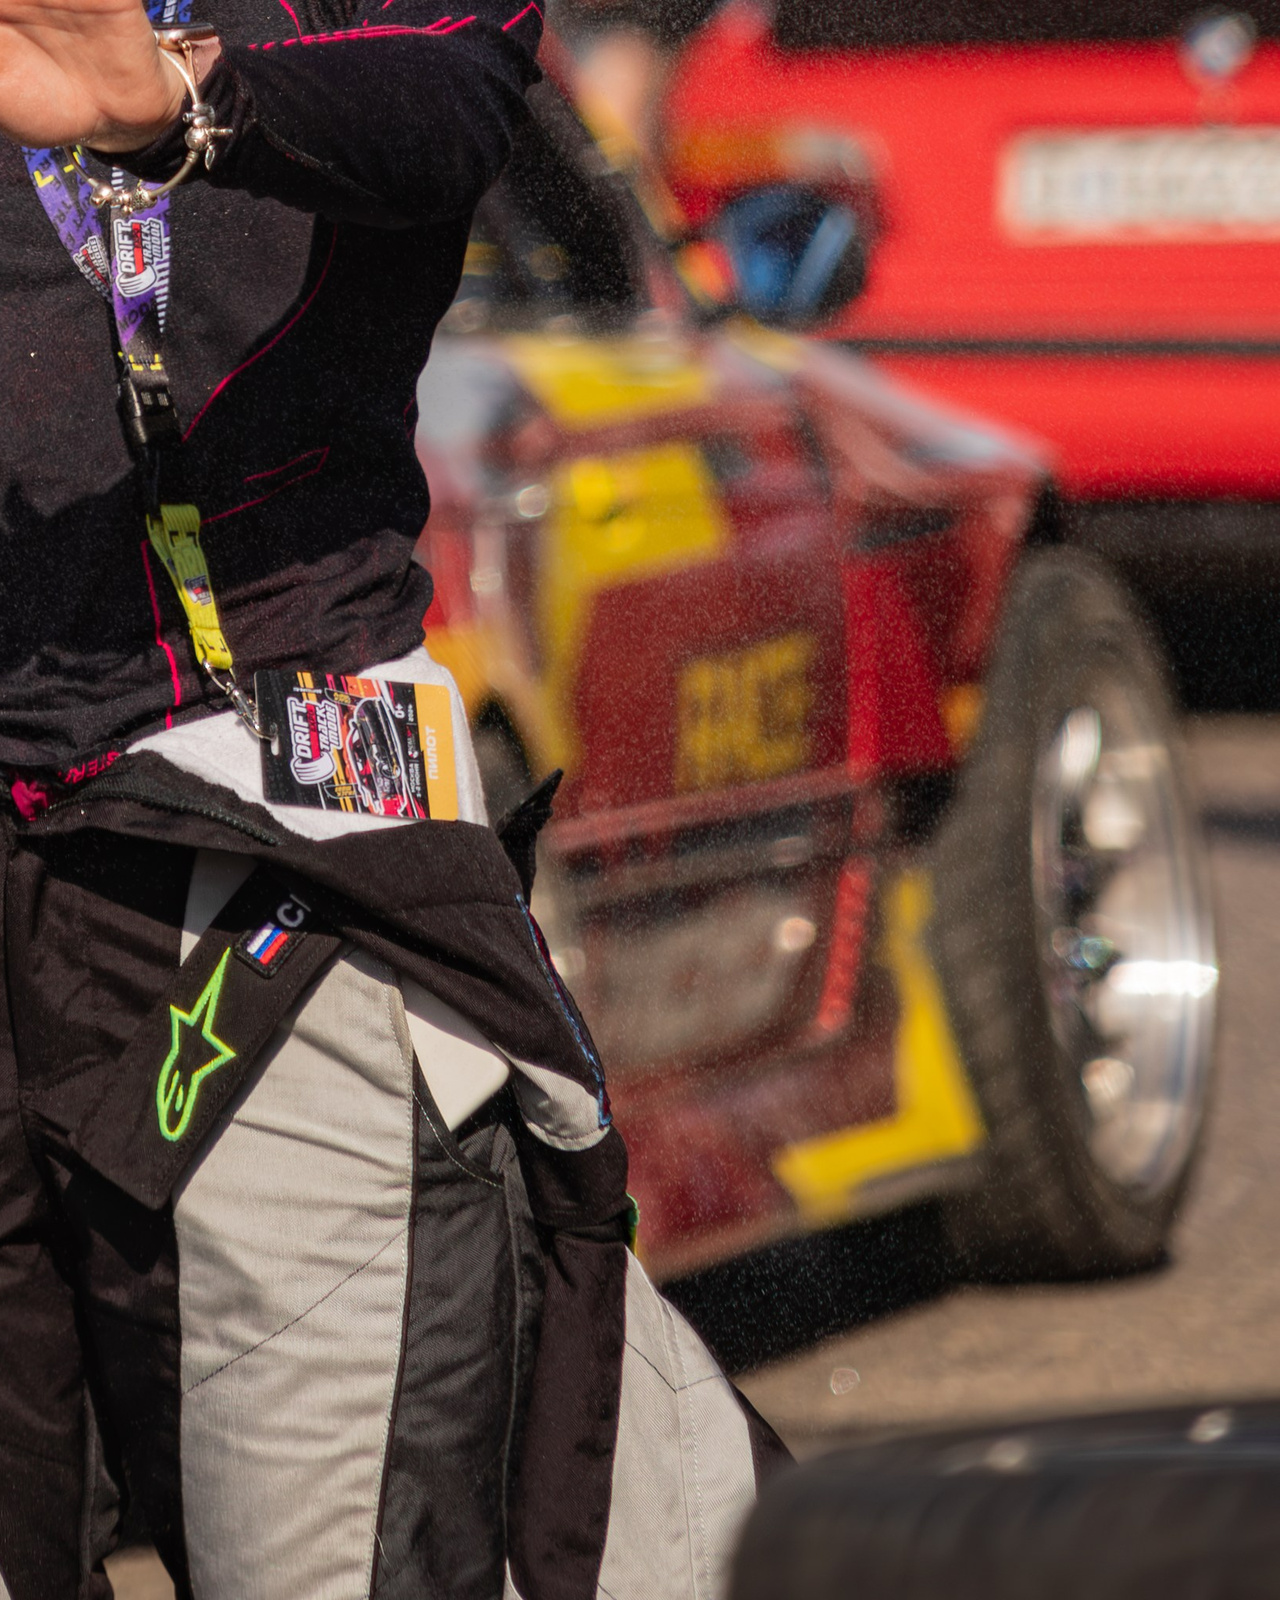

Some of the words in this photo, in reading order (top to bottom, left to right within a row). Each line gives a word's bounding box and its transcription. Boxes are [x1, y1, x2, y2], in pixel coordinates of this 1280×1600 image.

[117, 222, 137, 274] DRIFT
[149, 220, 163, 259] MODE
[290, 700, 313, 760] DRIFT
[324, 703, 341, 747] MODE
[394, 703, 406, 719] 0+
[425, 725, 439, 780] ПИЛОТ
